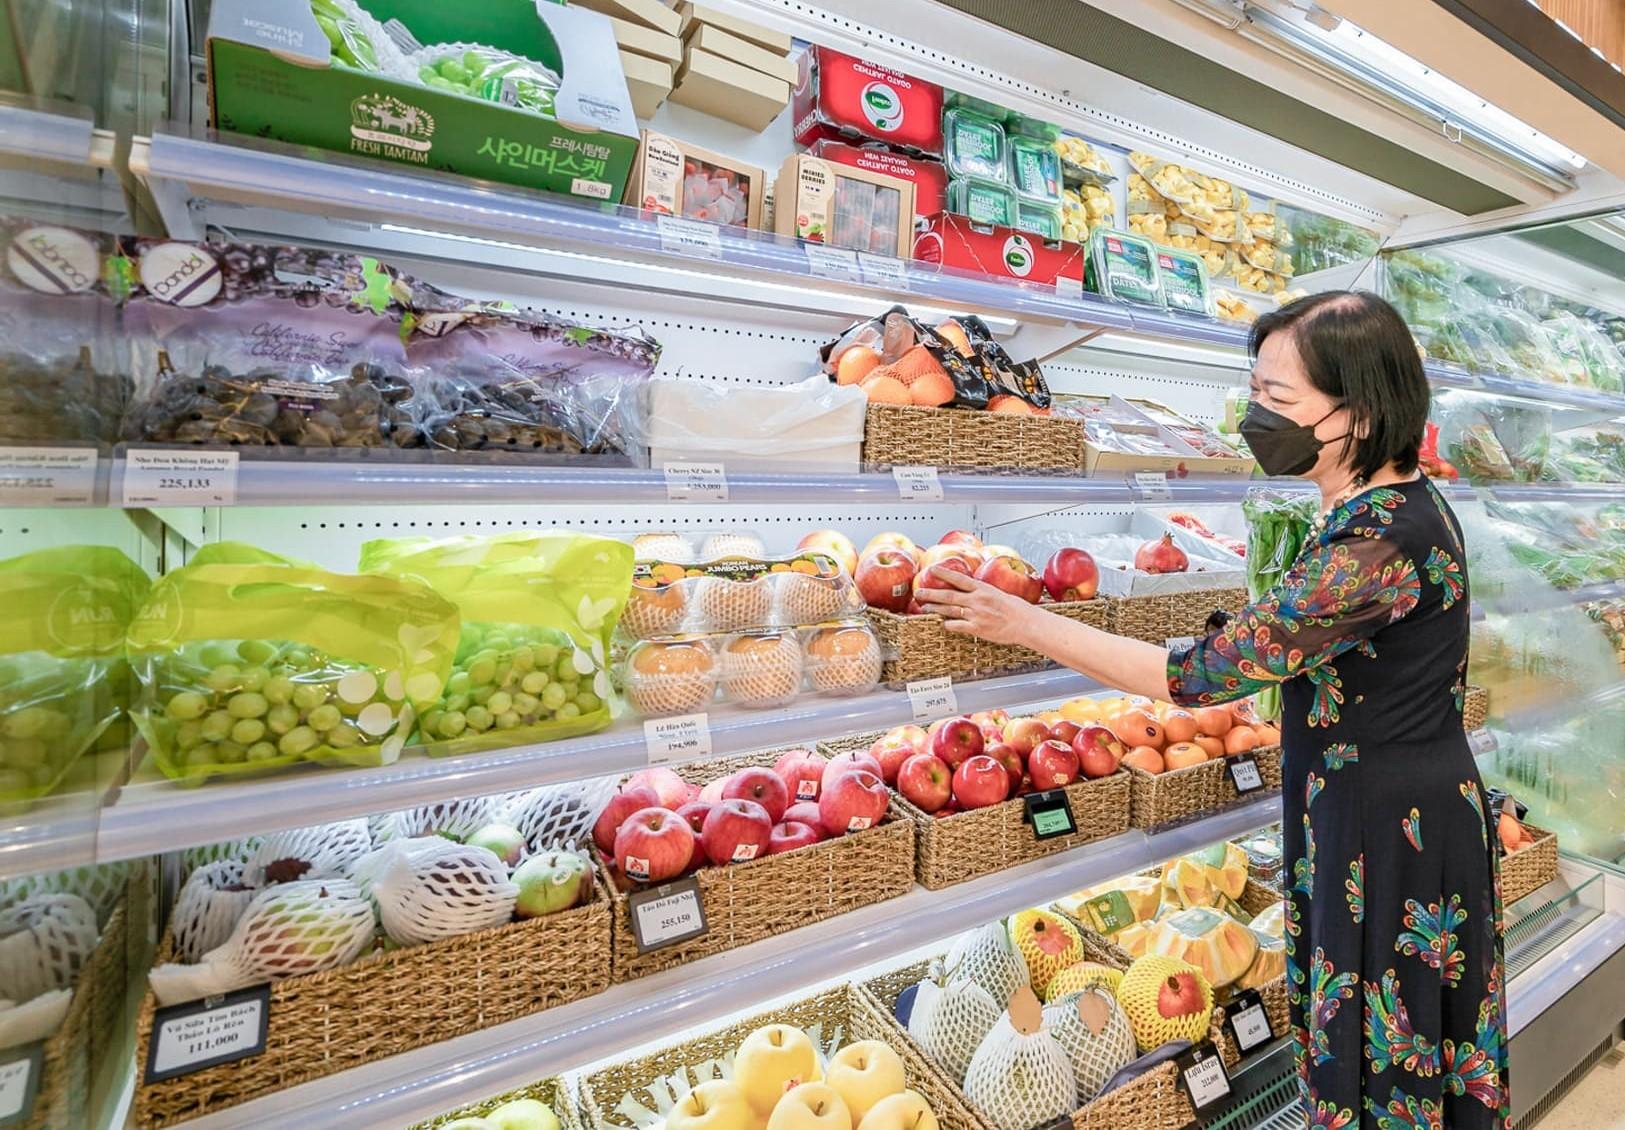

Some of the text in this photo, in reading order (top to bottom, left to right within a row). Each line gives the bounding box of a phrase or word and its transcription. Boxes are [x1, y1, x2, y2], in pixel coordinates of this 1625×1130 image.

[351, 138, 429, 164] FRESH TAMTAM
[477, 136, 607, 182] 샤인머스켓
[153, 252, 205, 296] pandol
[159, 478, 210, 489] 225,133
[707, 563, 767, 573] JUMBO PEARS
[661, 913, 691, 929] 255,150
[189, 1033, 239, 1054] 111,000
